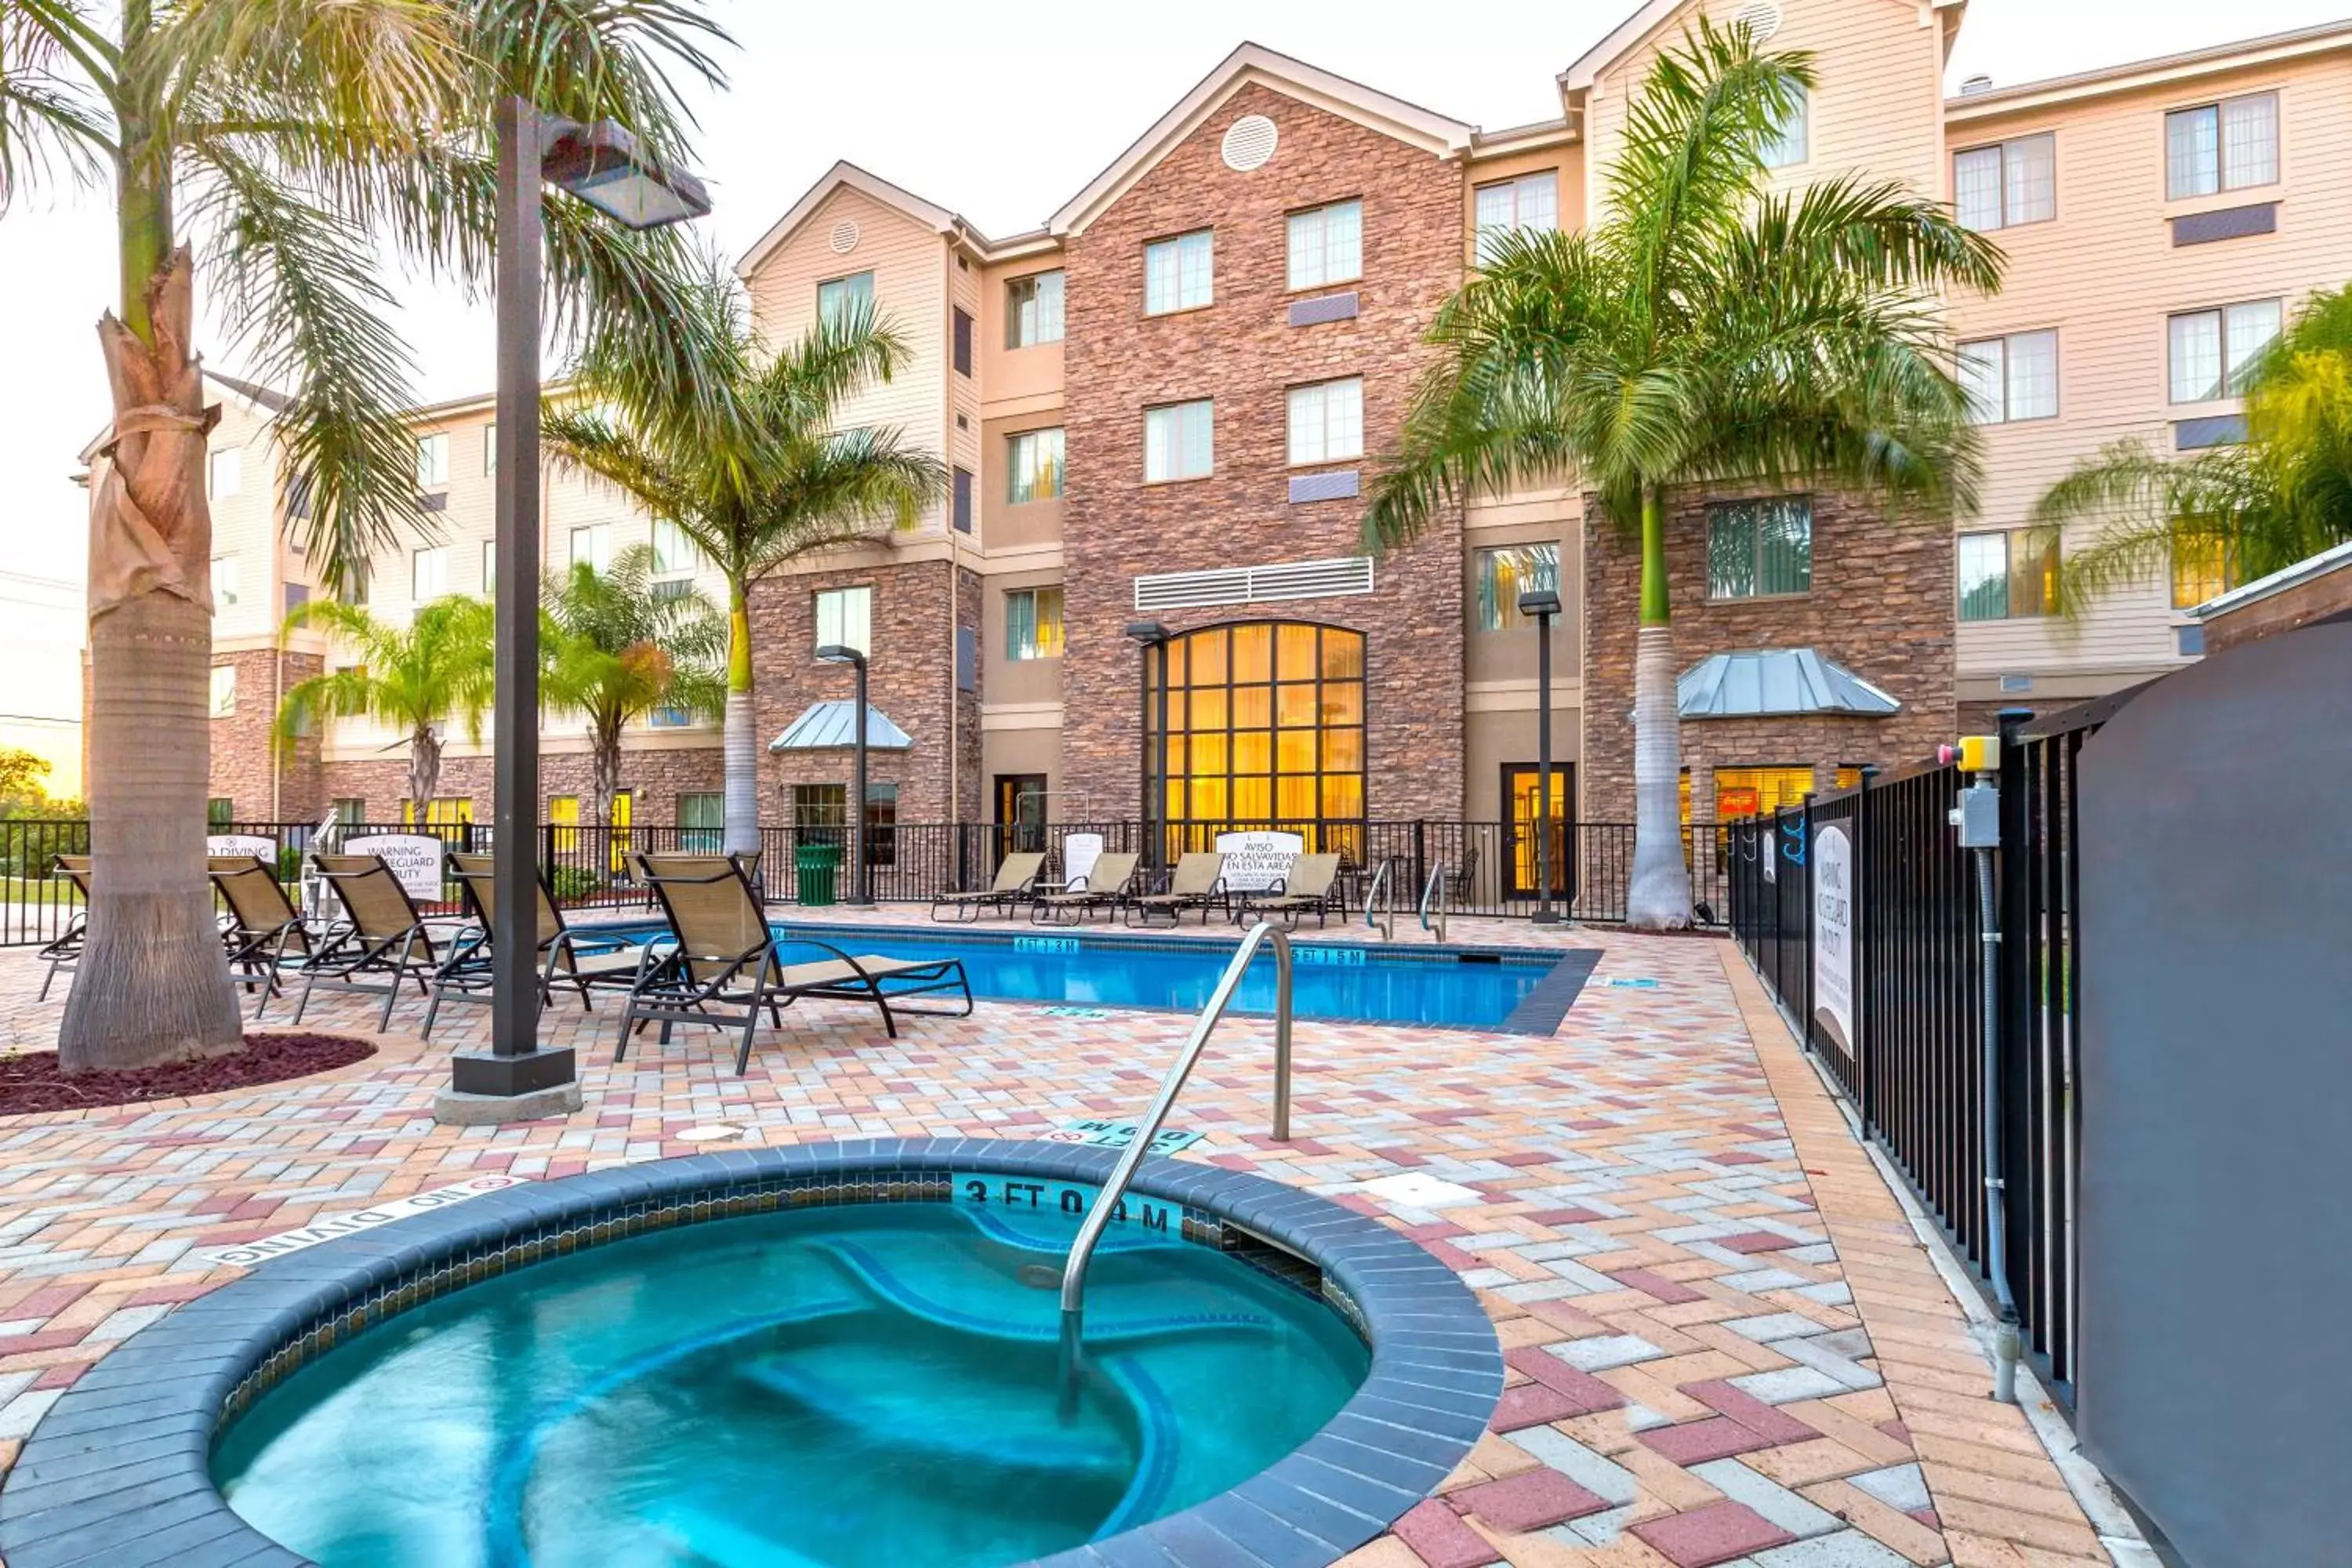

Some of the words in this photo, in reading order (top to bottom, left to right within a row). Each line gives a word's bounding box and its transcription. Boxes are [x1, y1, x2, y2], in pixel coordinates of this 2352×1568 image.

[220, 847, 269, 858] DIVING
[368, 846, 422, 856] WARNING
[408, 1188, 472, 1207] NO
[1005, 1181, 1045, 1208] FT
[1143, 1203, 1168, 1232] M
[220, 1210, 397, 1262] DIVING
